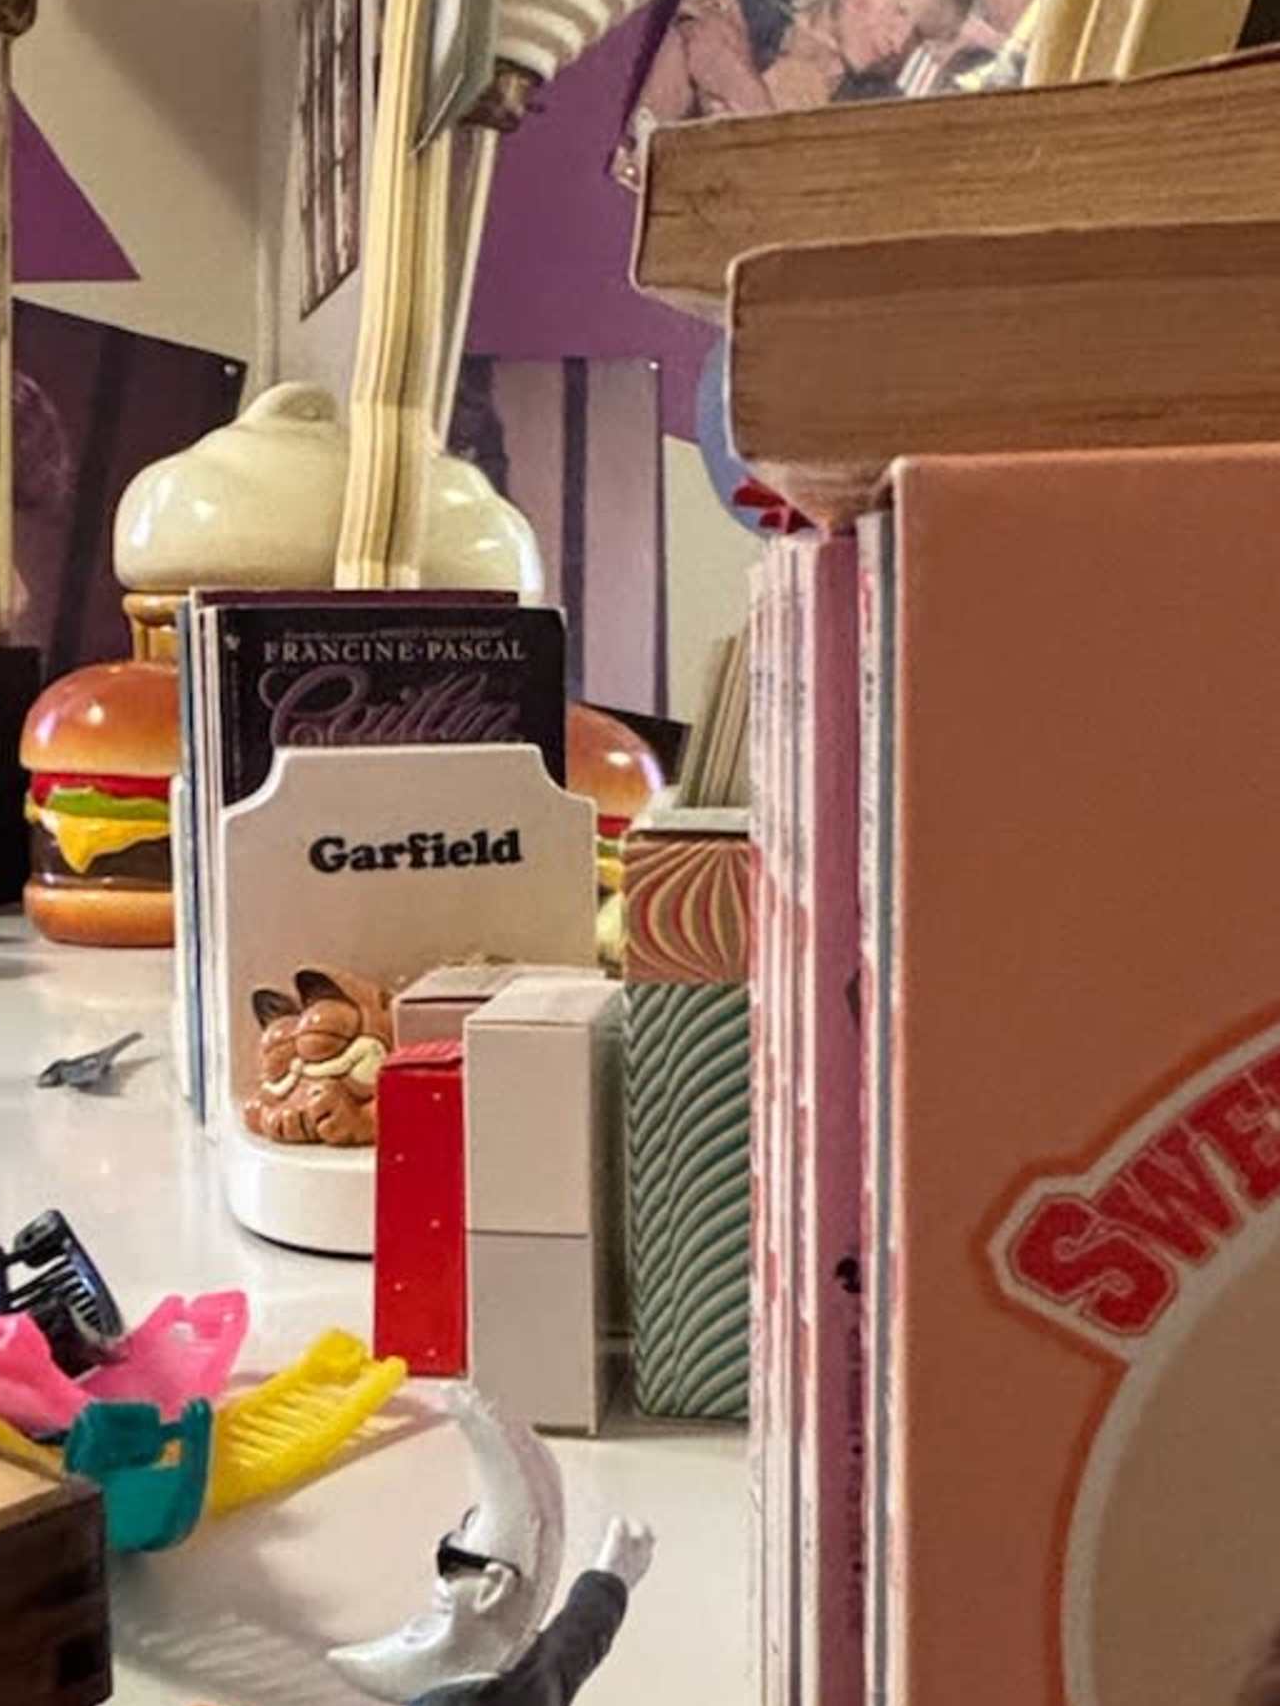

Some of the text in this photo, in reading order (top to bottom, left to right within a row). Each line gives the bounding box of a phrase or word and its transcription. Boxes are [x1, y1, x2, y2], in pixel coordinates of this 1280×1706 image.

[263, 640, 527, 664] FRANCINE PASCAL
[307, 828, 524, 874] Garfield
